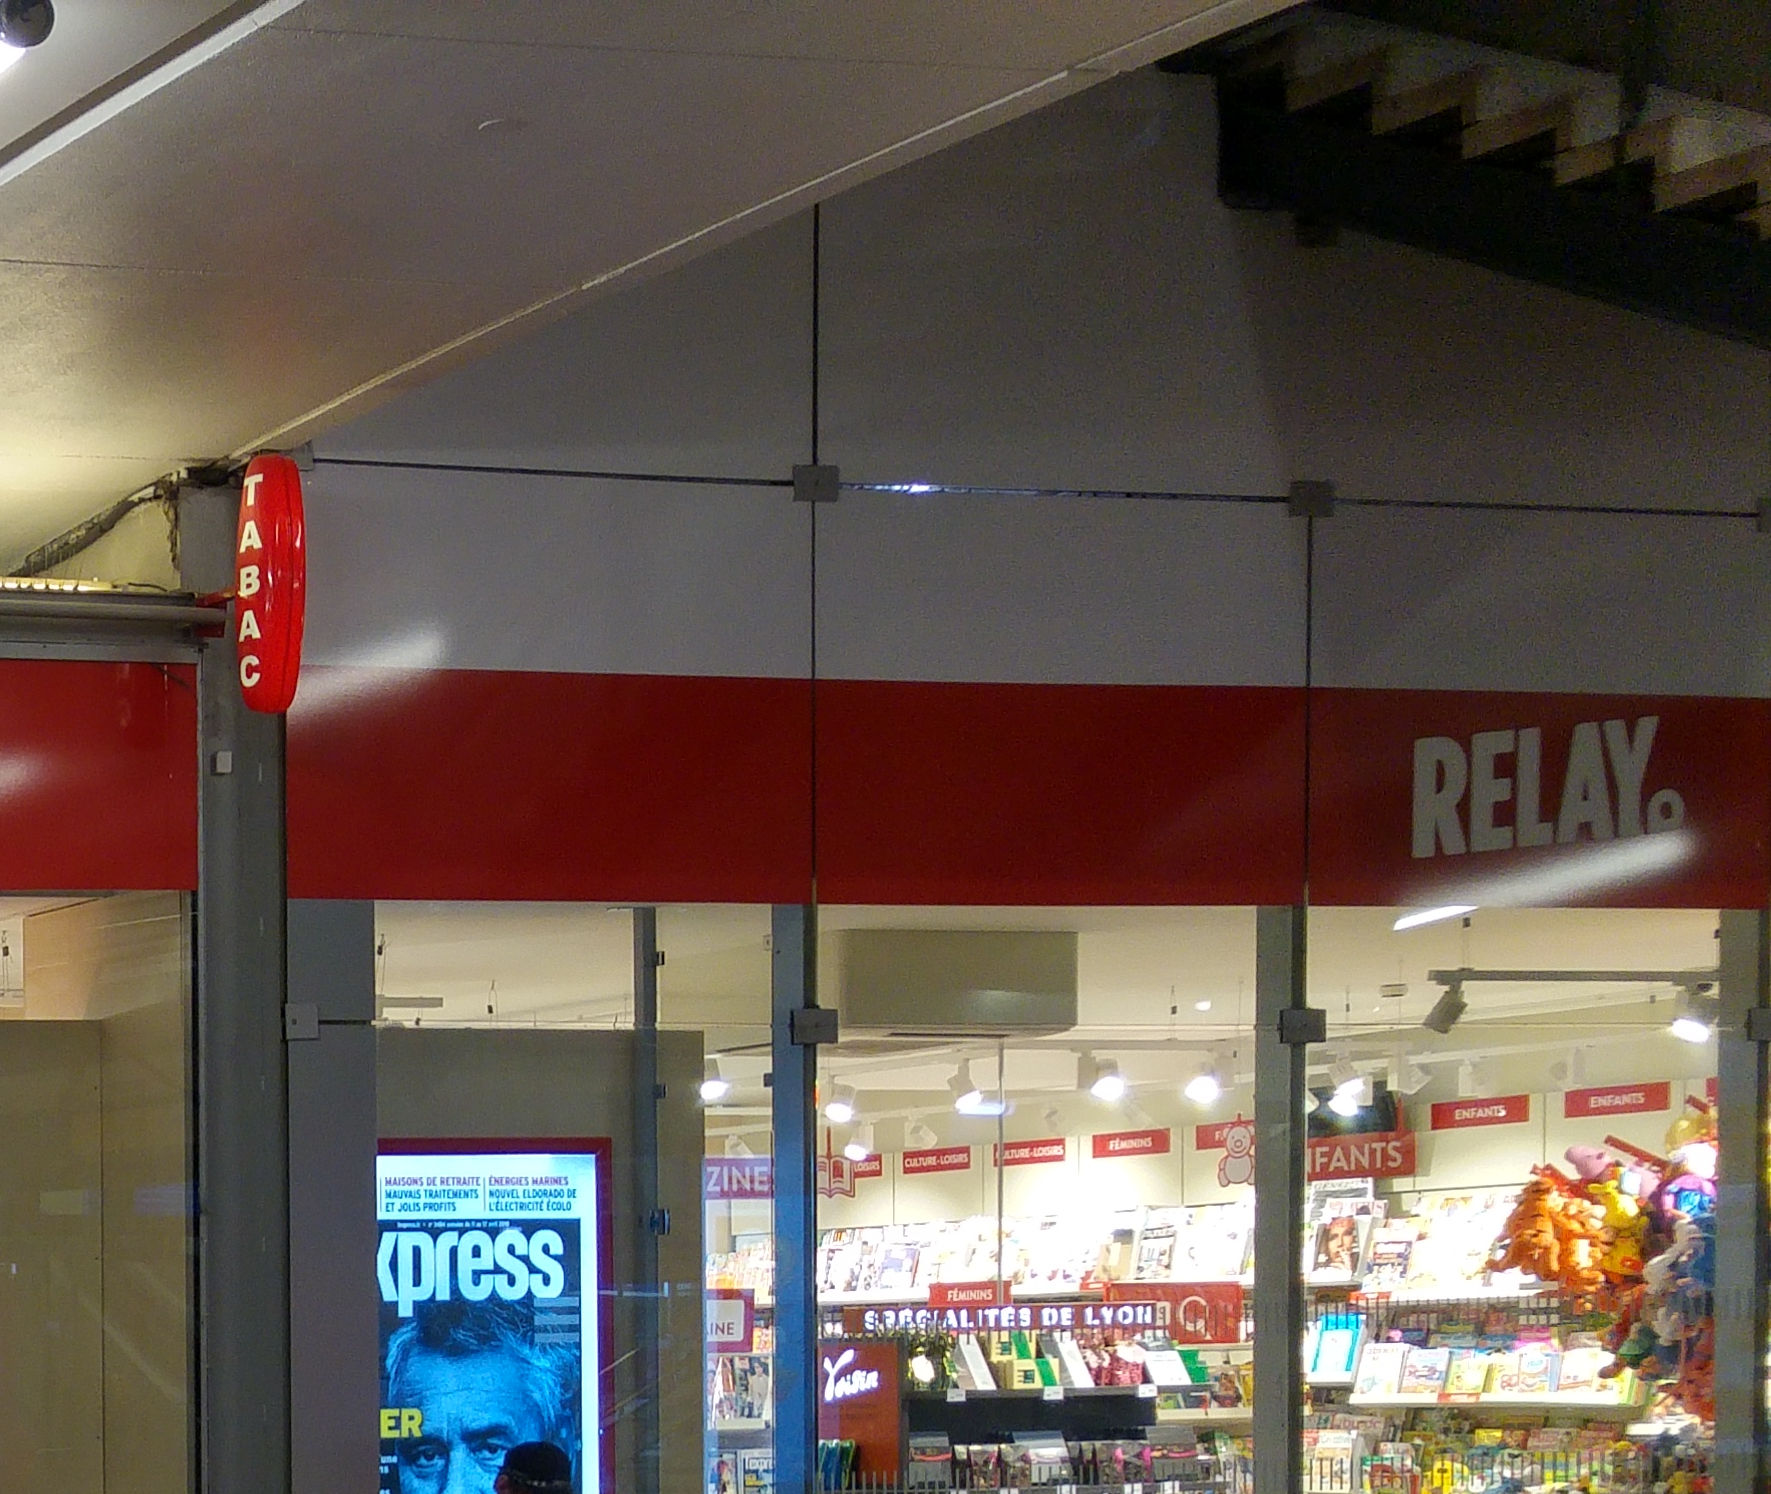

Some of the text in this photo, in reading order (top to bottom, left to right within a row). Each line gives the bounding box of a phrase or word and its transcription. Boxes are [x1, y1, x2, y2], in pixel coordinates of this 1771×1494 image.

[238, 473, 263, 688] TABAC
[1590, 1093, 1645, 1109] ENFANTS
[1454, 1105, 1506, 1119] ENFANTS
[385, 1176, 481, 1187] MAISONS DE RETRAITE
[488, 1174, 569, 1187] ÉNERGIES MARINES
[385, 1189, 479, 1199] MAUVAIS TRAITEMENTS
[488, 1188, 577, 1199] NOUVEL ELDORADO DE
[385, 1202, 457, 1212] ET JOLIS PROFITS
[488, 1200, 571, 1212] L'ÉLECTRICITÉ ÉCOLO
[947, 1288, 993, 1302] FÉMININS
[1042, 1306, 1074, 1327] DE
[1085, 1304, 1154, 1326] LYON
[380, 1408, 423, 1438] ER
